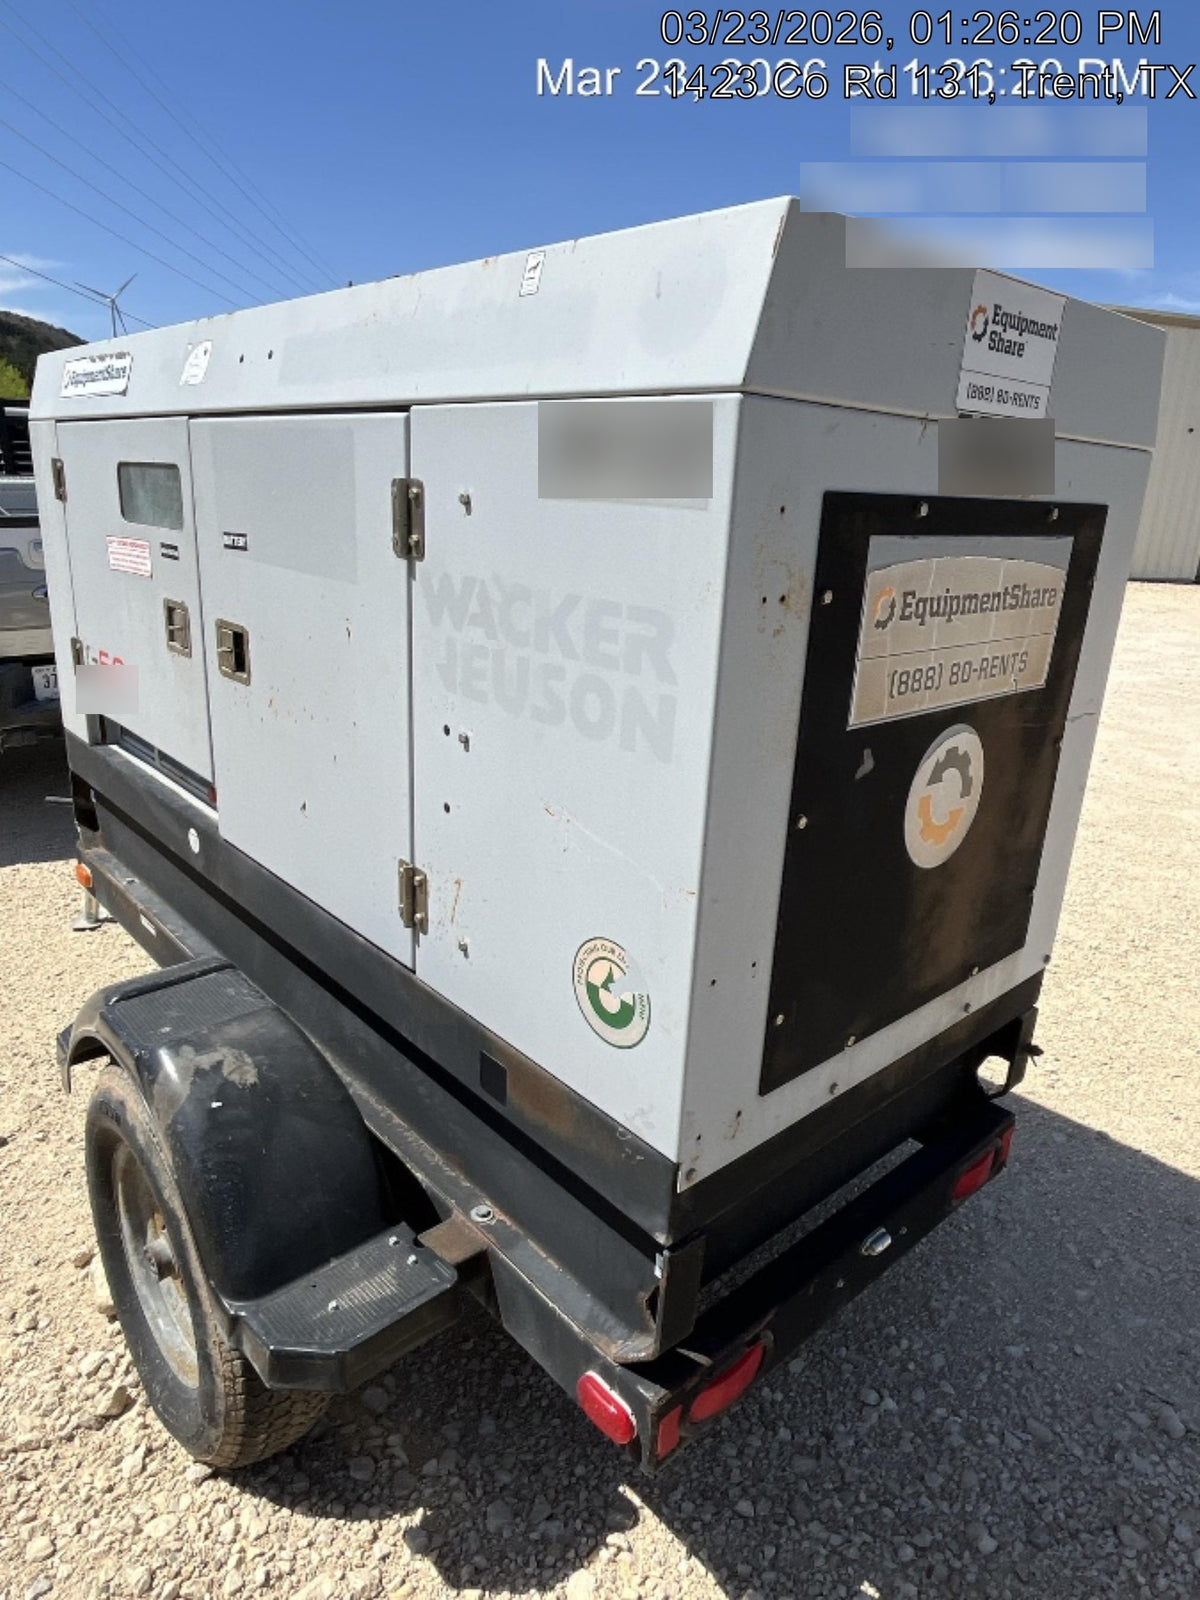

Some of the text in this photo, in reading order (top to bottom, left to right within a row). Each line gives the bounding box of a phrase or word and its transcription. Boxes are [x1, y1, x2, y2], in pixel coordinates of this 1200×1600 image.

[988, 330, 1025, 358] Share
[992, 303, 1058, 341] Equipment
[899, 583, 1058, 627] EquipmentShare
[421, 569, 679, 687] WACKER
[889, 651, 1029, 699] (888) 80-RENTS
